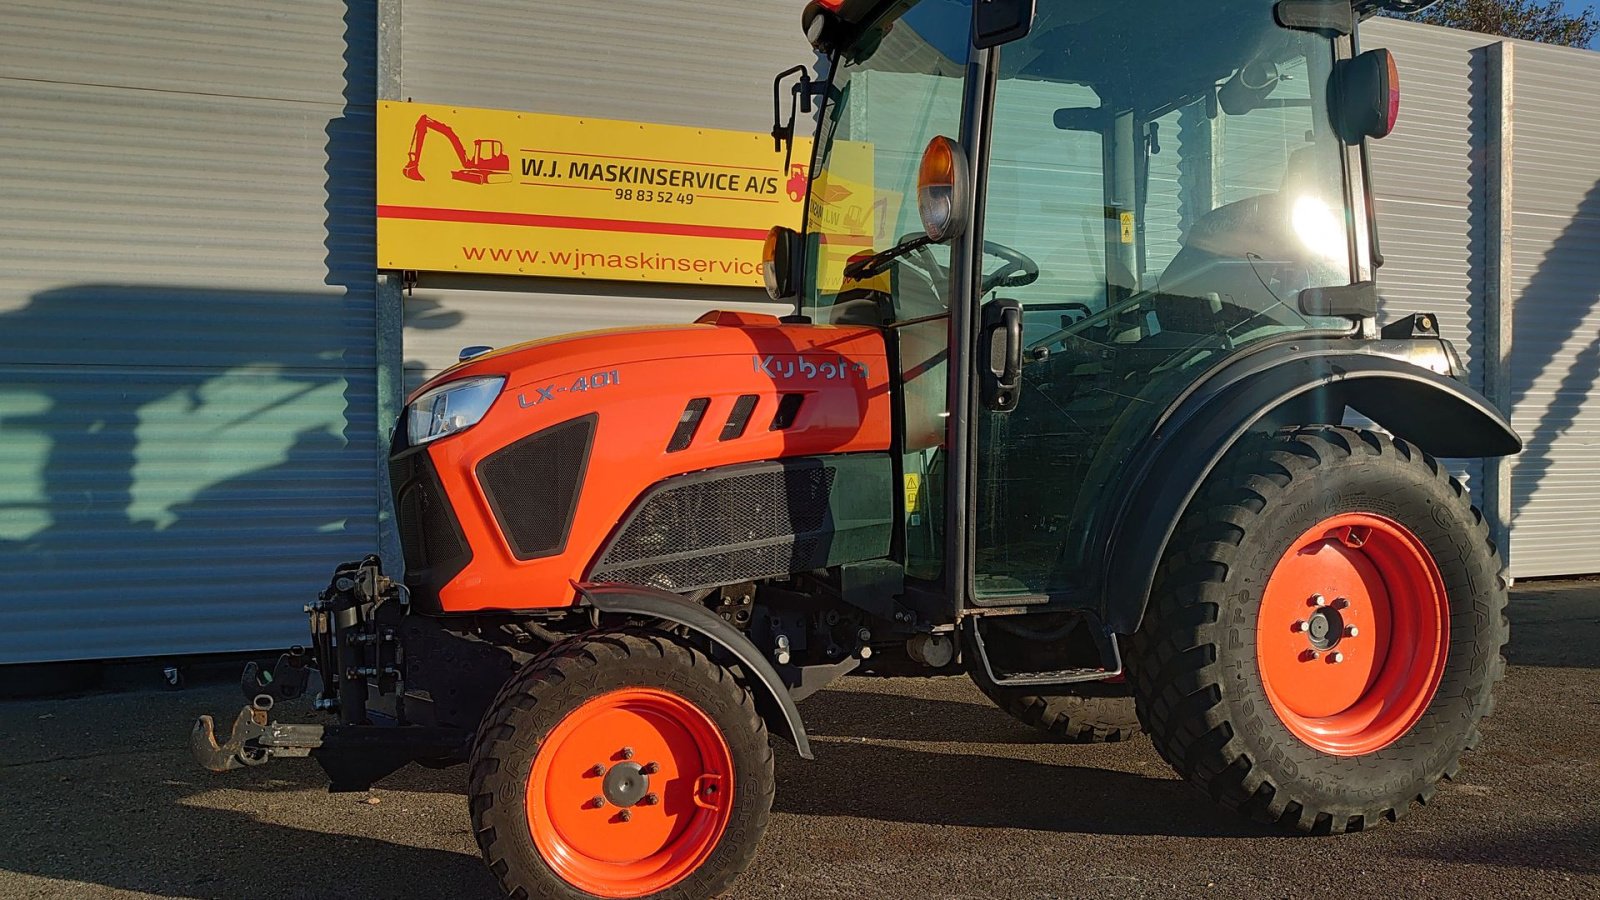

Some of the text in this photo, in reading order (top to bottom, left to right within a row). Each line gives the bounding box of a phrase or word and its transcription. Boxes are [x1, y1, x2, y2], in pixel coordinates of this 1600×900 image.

[521, 158, 778, 195] W.J. MASKINSERVICE A/S
[615, 187, 694, 205] 98 83 52 49
[753, 355, 870, 380] Kubota
[518, 369, 620, 409] LX-401
[499, 671, 600, 806] GALAXY
